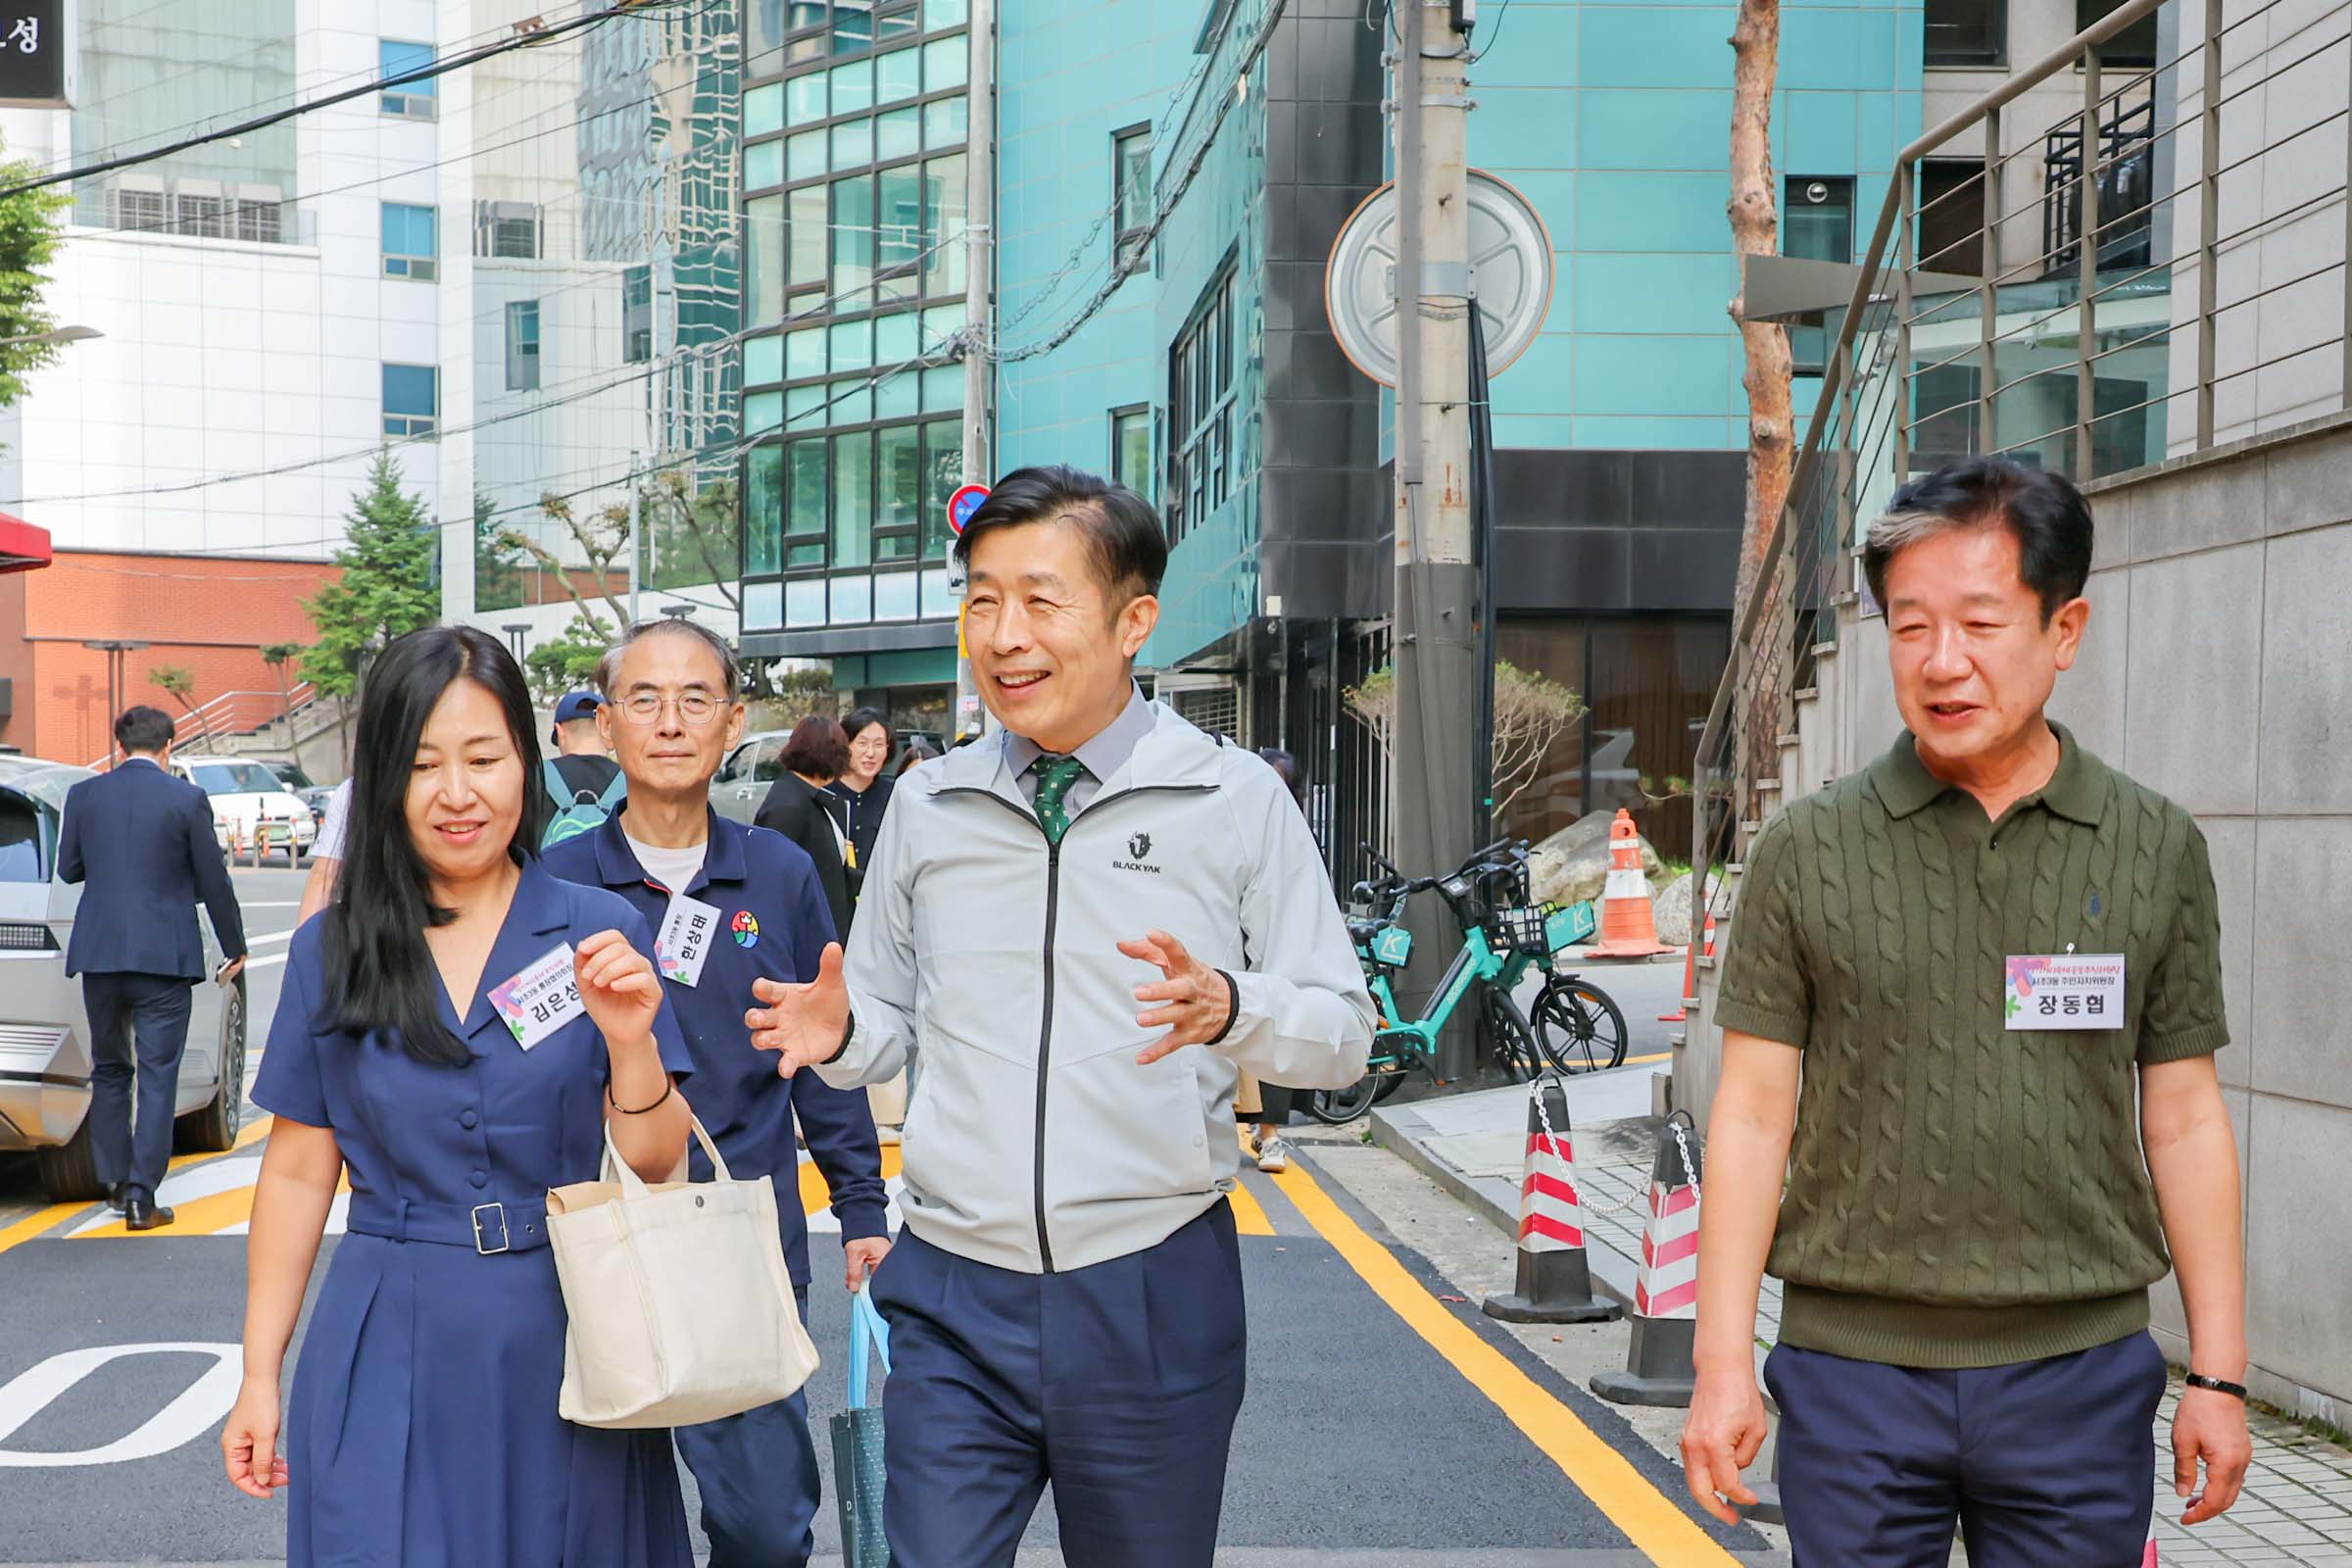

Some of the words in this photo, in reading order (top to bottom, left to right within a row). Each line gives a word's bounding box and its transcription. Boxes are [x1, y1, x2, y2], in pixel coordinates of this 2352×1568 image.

[0, 16, 38, 54] 성
[681, 914, 708, 960] 한상태
[2038, 995, 2104, 1015] 장동협
